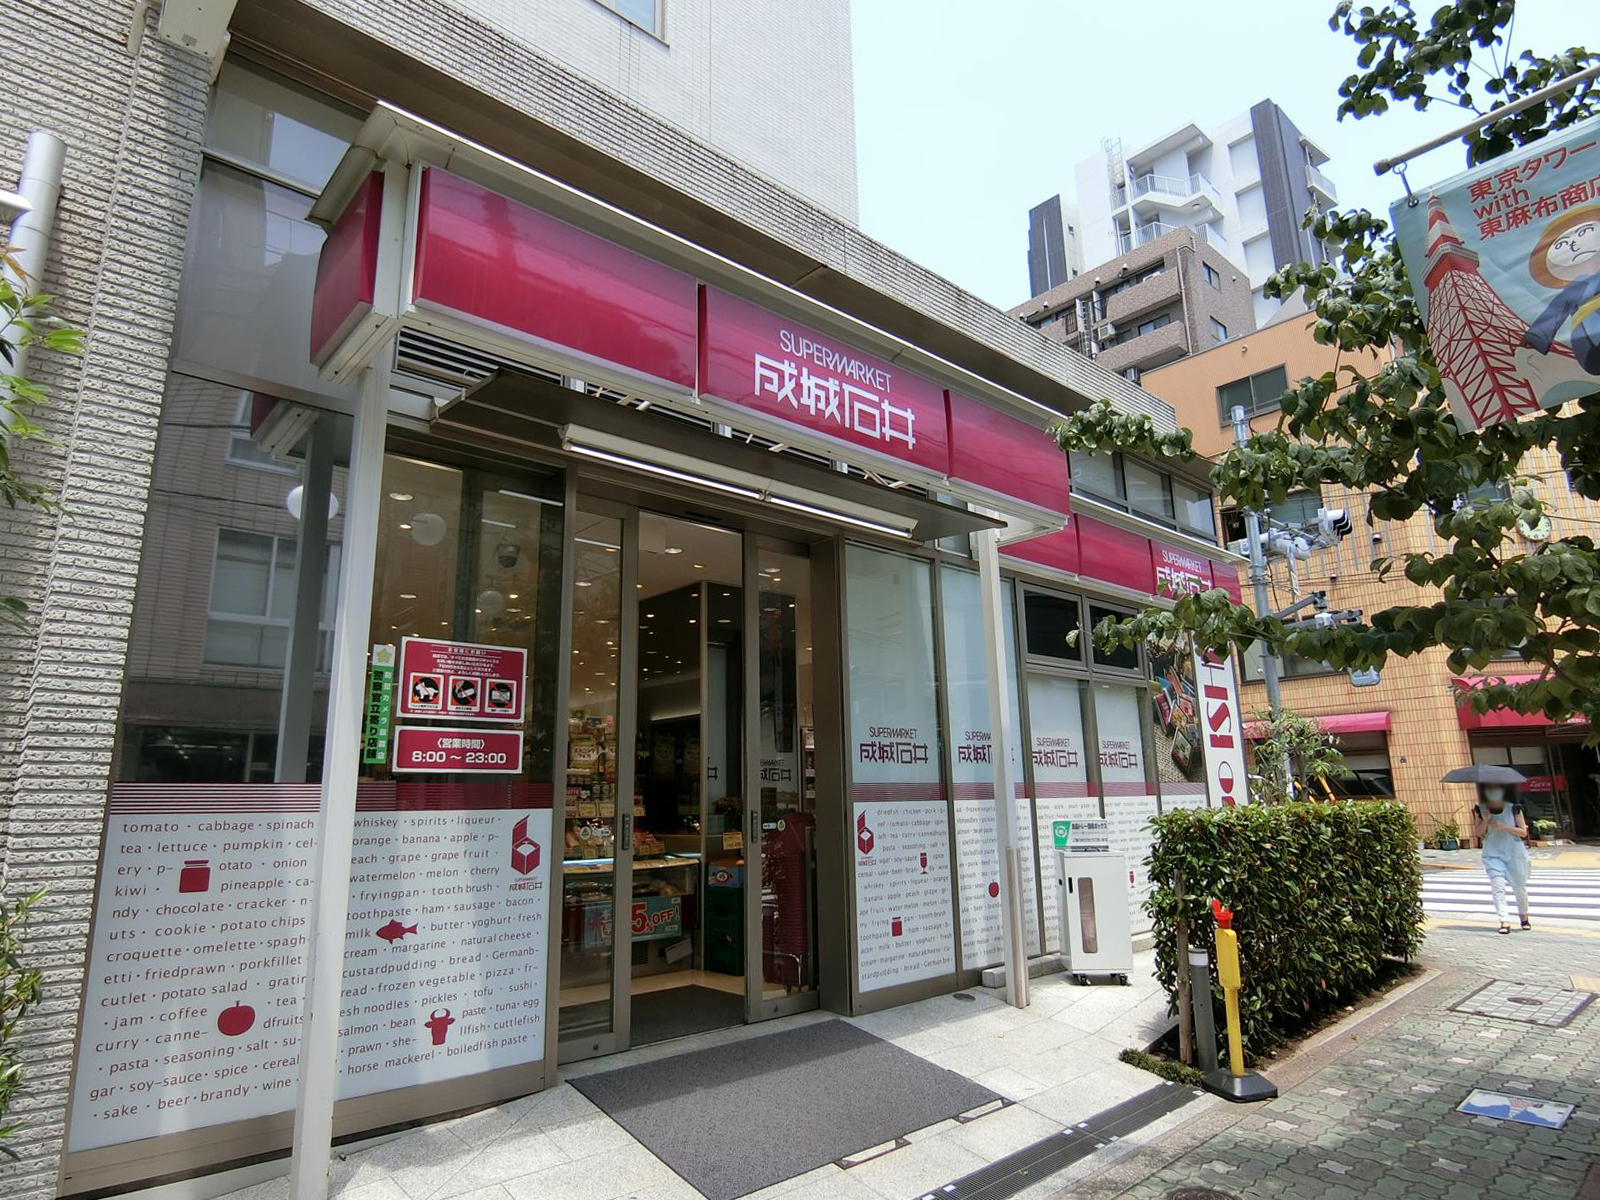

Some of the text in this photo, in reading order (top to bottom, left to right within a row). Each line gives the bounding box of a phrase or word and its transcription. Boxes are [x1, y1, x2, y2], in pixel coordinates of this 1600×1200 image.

[1467, 141, 1597, 204] 東京タワー
[1473, 188, 1530, 219] with
[779, 329, 892, 393] SUPERMARKET
[754, 353, 916, 450] 成城石井
[869, 726, 917, 739] SUPERMARKET
[860, 741, 928, 764] 成城石井
[123, 819, 314, 833] tomato cabbage spinach
[354, 816, 495, 828] whiskey spirits liqueur
[121, 845, 141, 854] tea
[157, 842, 208, 853] lettuce
[223, 839, 283, 853] pumpkin
[352, 837, 391, 847] orange
[402, 835, 440, 844] banana
[450, 832, 479, 844] apple
[351, 849, 489, 865] each grape grape fruit
[117, 866, 142, 877] ery
[219, 861, 252, 871] otato
[273, 858, 307, 869] onion
[426, 868, 458, 878] melon
[470, 866, 500, 876] cherry
[115, 885, 146, 897] kiwi
[220, 878, 284, 893] pineapple
[360, 882, 492, 902] fryingpan tooth brush
[112, 906, 140, 919] ndy
[156, 902, 224, 915] chocolate
[236, 898, 287, 910] cracker
[422, 905, 444, 914] ham
[454, 901, 496, 911] sausage
[506, 898, 534, 907] bacon
[109, 916, 305, 940] uts cookie potato chips
[430, 912, 542, 931] butter yoghurt fresh
[345, 928, 371, 940] milk
[106, 947, 182, 962] croquette
[193, 941, 256, 954] omelette
[344, 948, 377, 959] cream
[391, 938, 446, 953] margarine
[449, 952, 482, 965] bread
[104, 971, 132, 985] etti
[341, 984, 367, 997] read
[378, 981, 415, 993] frozen
[419, 971, 475, 987] vegetable
[485, 967, 514, 980] pizza
[101, 992, 146, 1007] cutlet
[161, 986, 206, 1003] potato
[211, 980, 248, 994] salad
[276, 997, 297, 1007] tea
[339, 981, 532, 1017] esh noodles pickles tofu sushi
[111, 1007, 207, 1031] jam coffee
[338, 998, 539, 1037] salmon bean paste tuna egg
[95, 1039, 139, 1053] curry
[347, 1062, 379, 1075] horse
[384, 1050, 434, 1068] mackerel
[501, 1035, 527, 1048] paste
[348, 1042, 382, 1057] prawn
[109, 1059, 149, 1076] pasta
[163, 1046, 235, 1065] seasoning
[246, 1039, 269, 1052] salt
[90, 1054, 300, 1102] gar soy-sauce spice cereal
[103, 1079, 291, 1120] sake beer brandy wine
